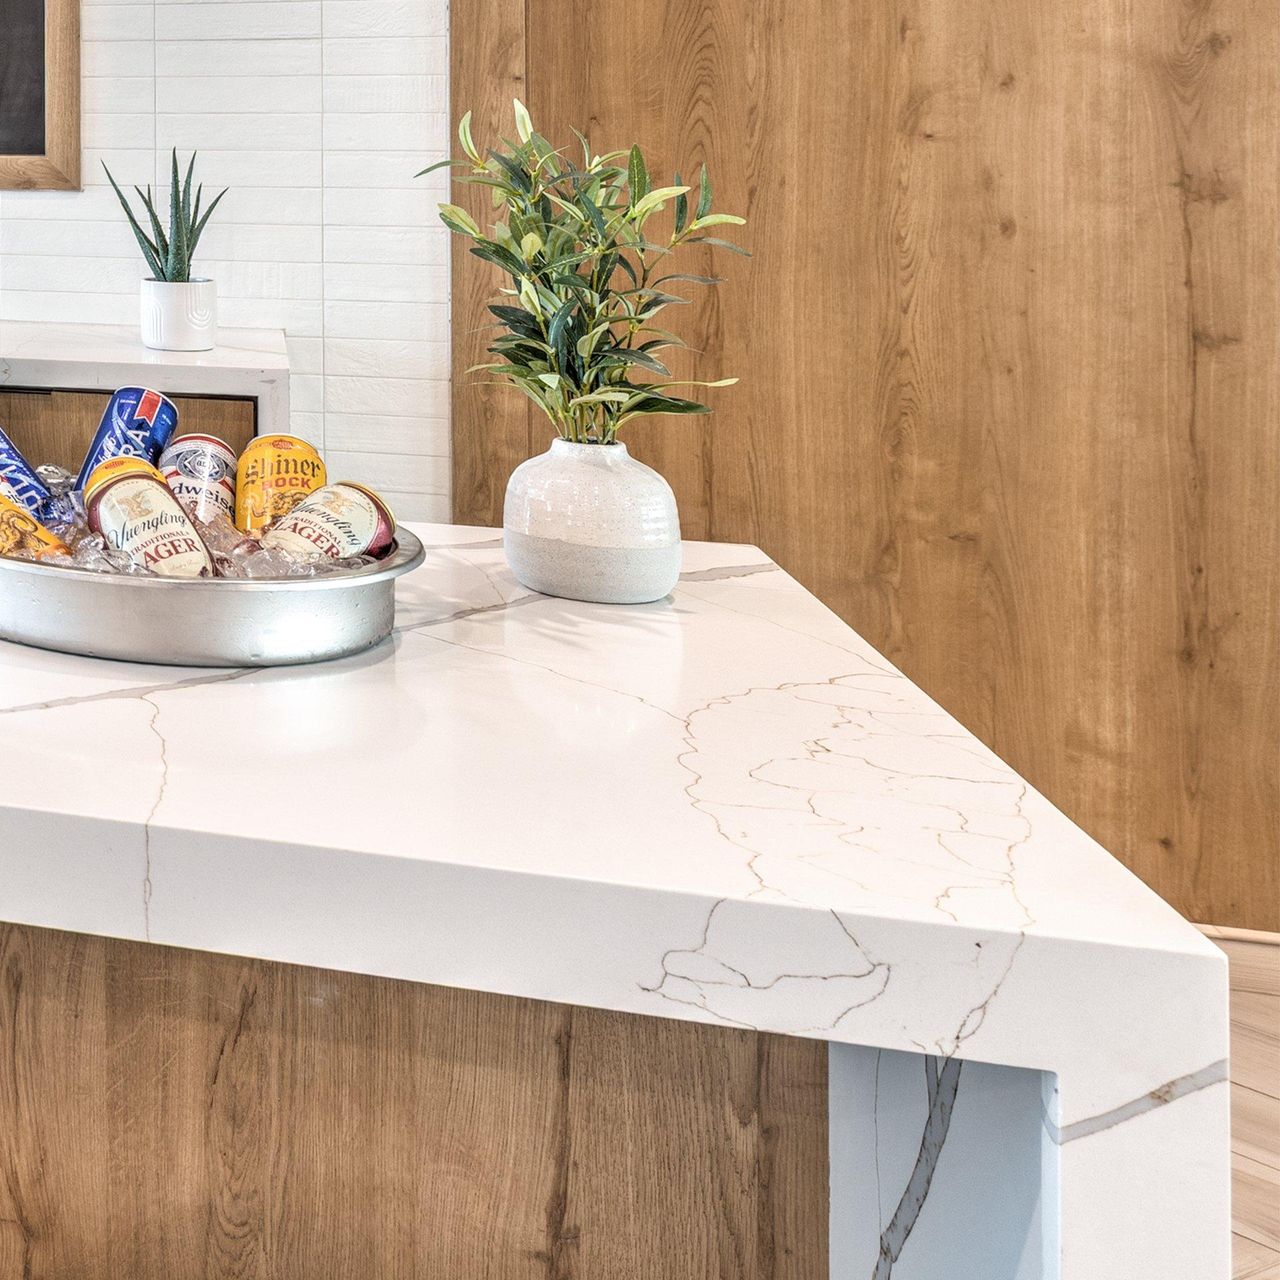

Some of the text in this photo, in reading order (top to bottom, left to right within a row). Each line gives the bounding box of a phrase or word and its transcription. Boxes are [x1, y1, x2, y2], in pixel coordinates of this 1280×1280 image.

[243, 455, 321, 488] Shiner
[262, 477, 312, 490] BOCK
[107, 511, 187, 550] Yuengling
[290, 516, 342, 546] TRADITIONAL
[291, 501, 362, 547] Yuengling
[130, 530, 187, 556] TRADITIONAL
[143, 537, 201, 568] AGER
